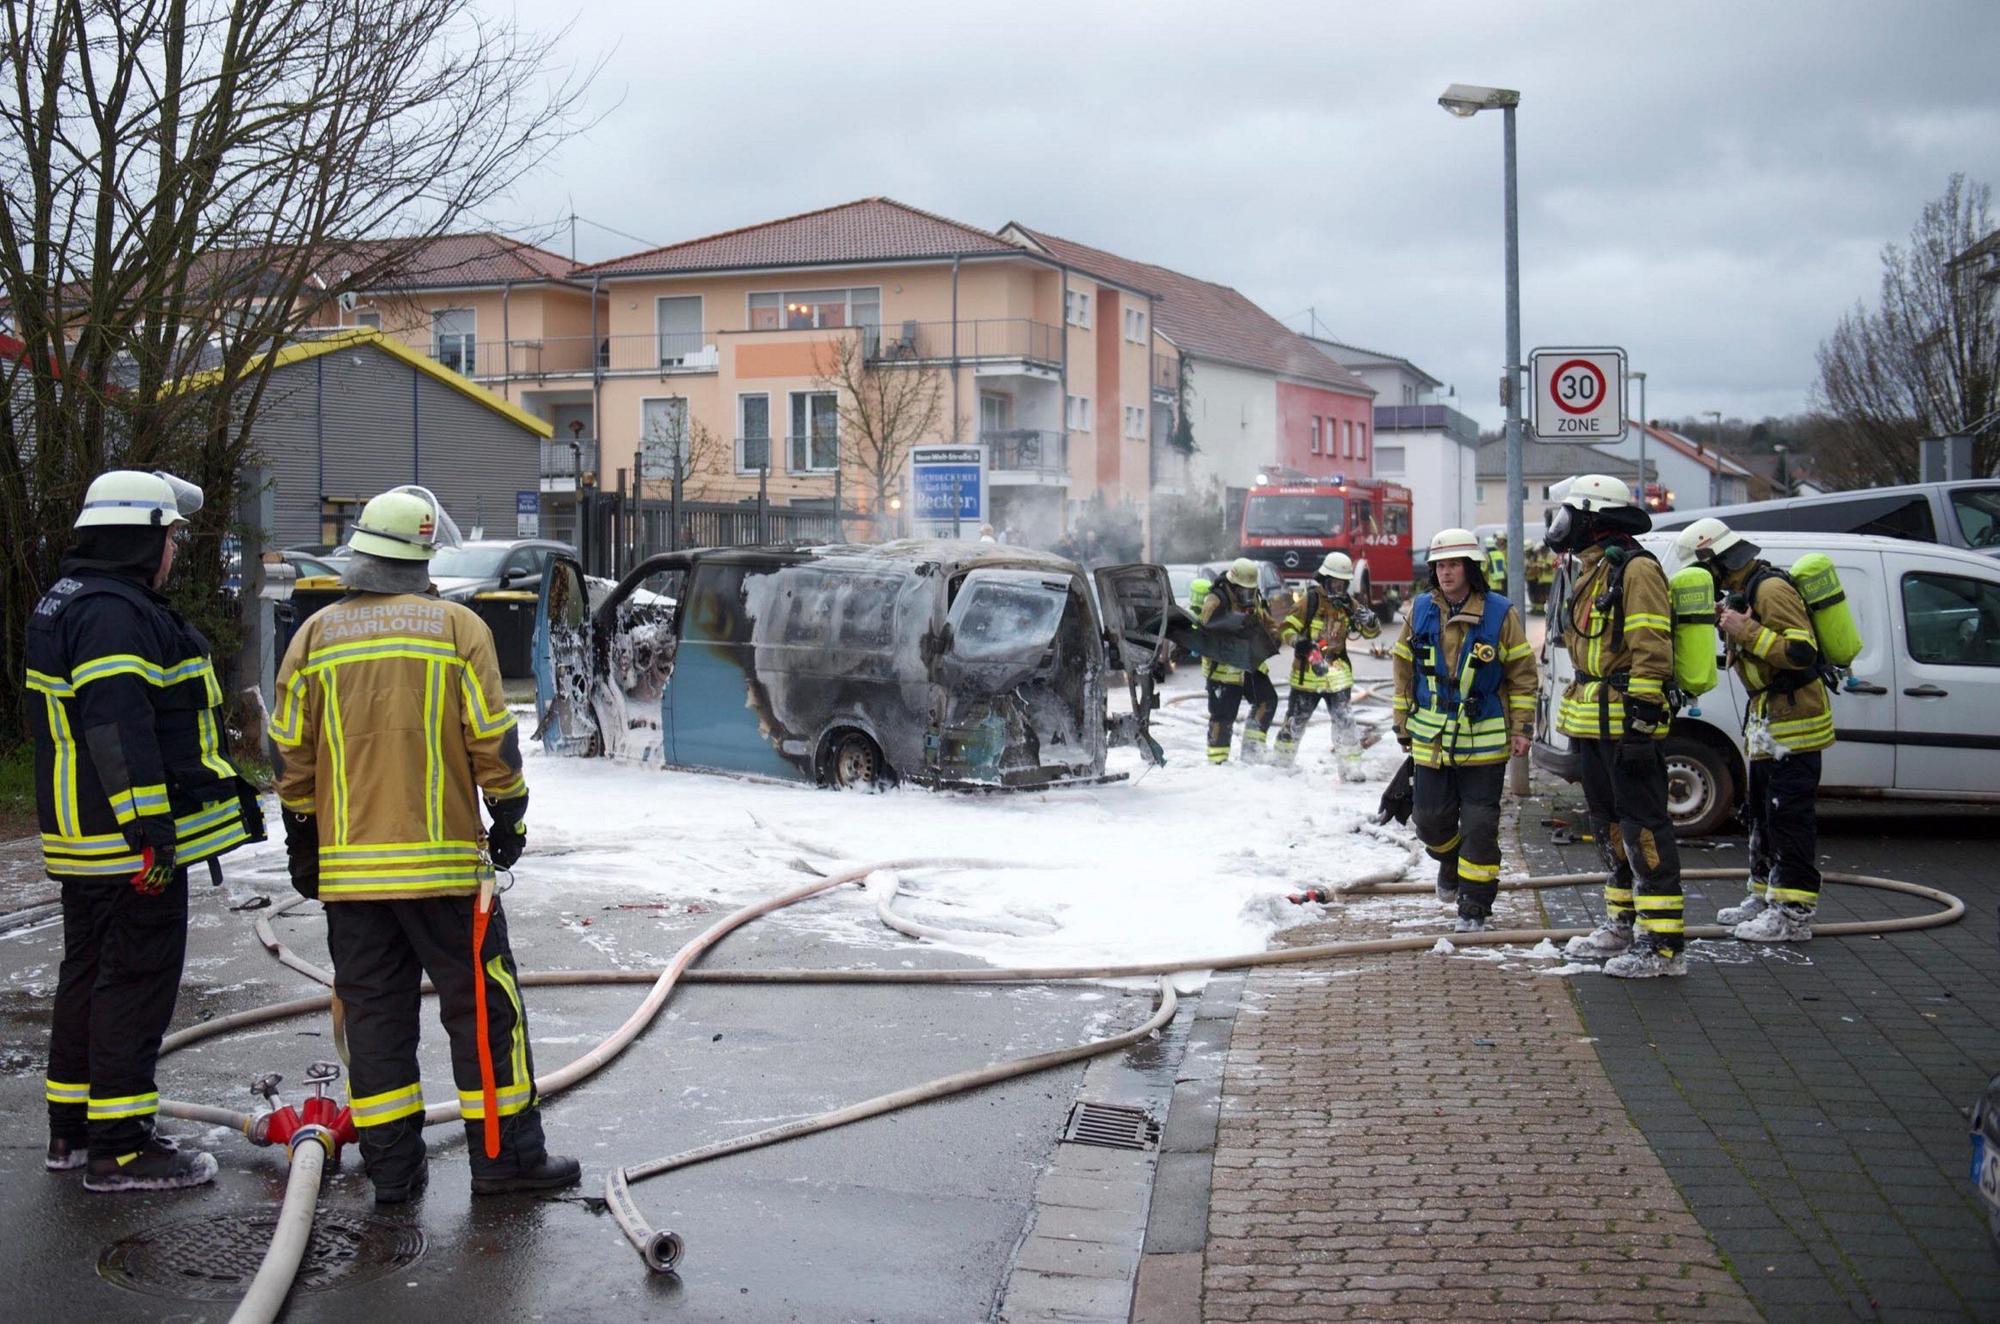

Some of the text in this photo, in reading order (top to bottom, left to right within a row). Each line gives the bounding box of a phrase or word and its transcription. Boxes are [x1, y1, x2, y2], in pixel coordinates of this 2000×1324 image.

[1562, 375, 1594, 399] 30
[1558, 418, 1599, 432] ZONE
[322, 604, 445, 624] FEUERWEHR
[323, 620, 445, 641] SAARLOUIS
